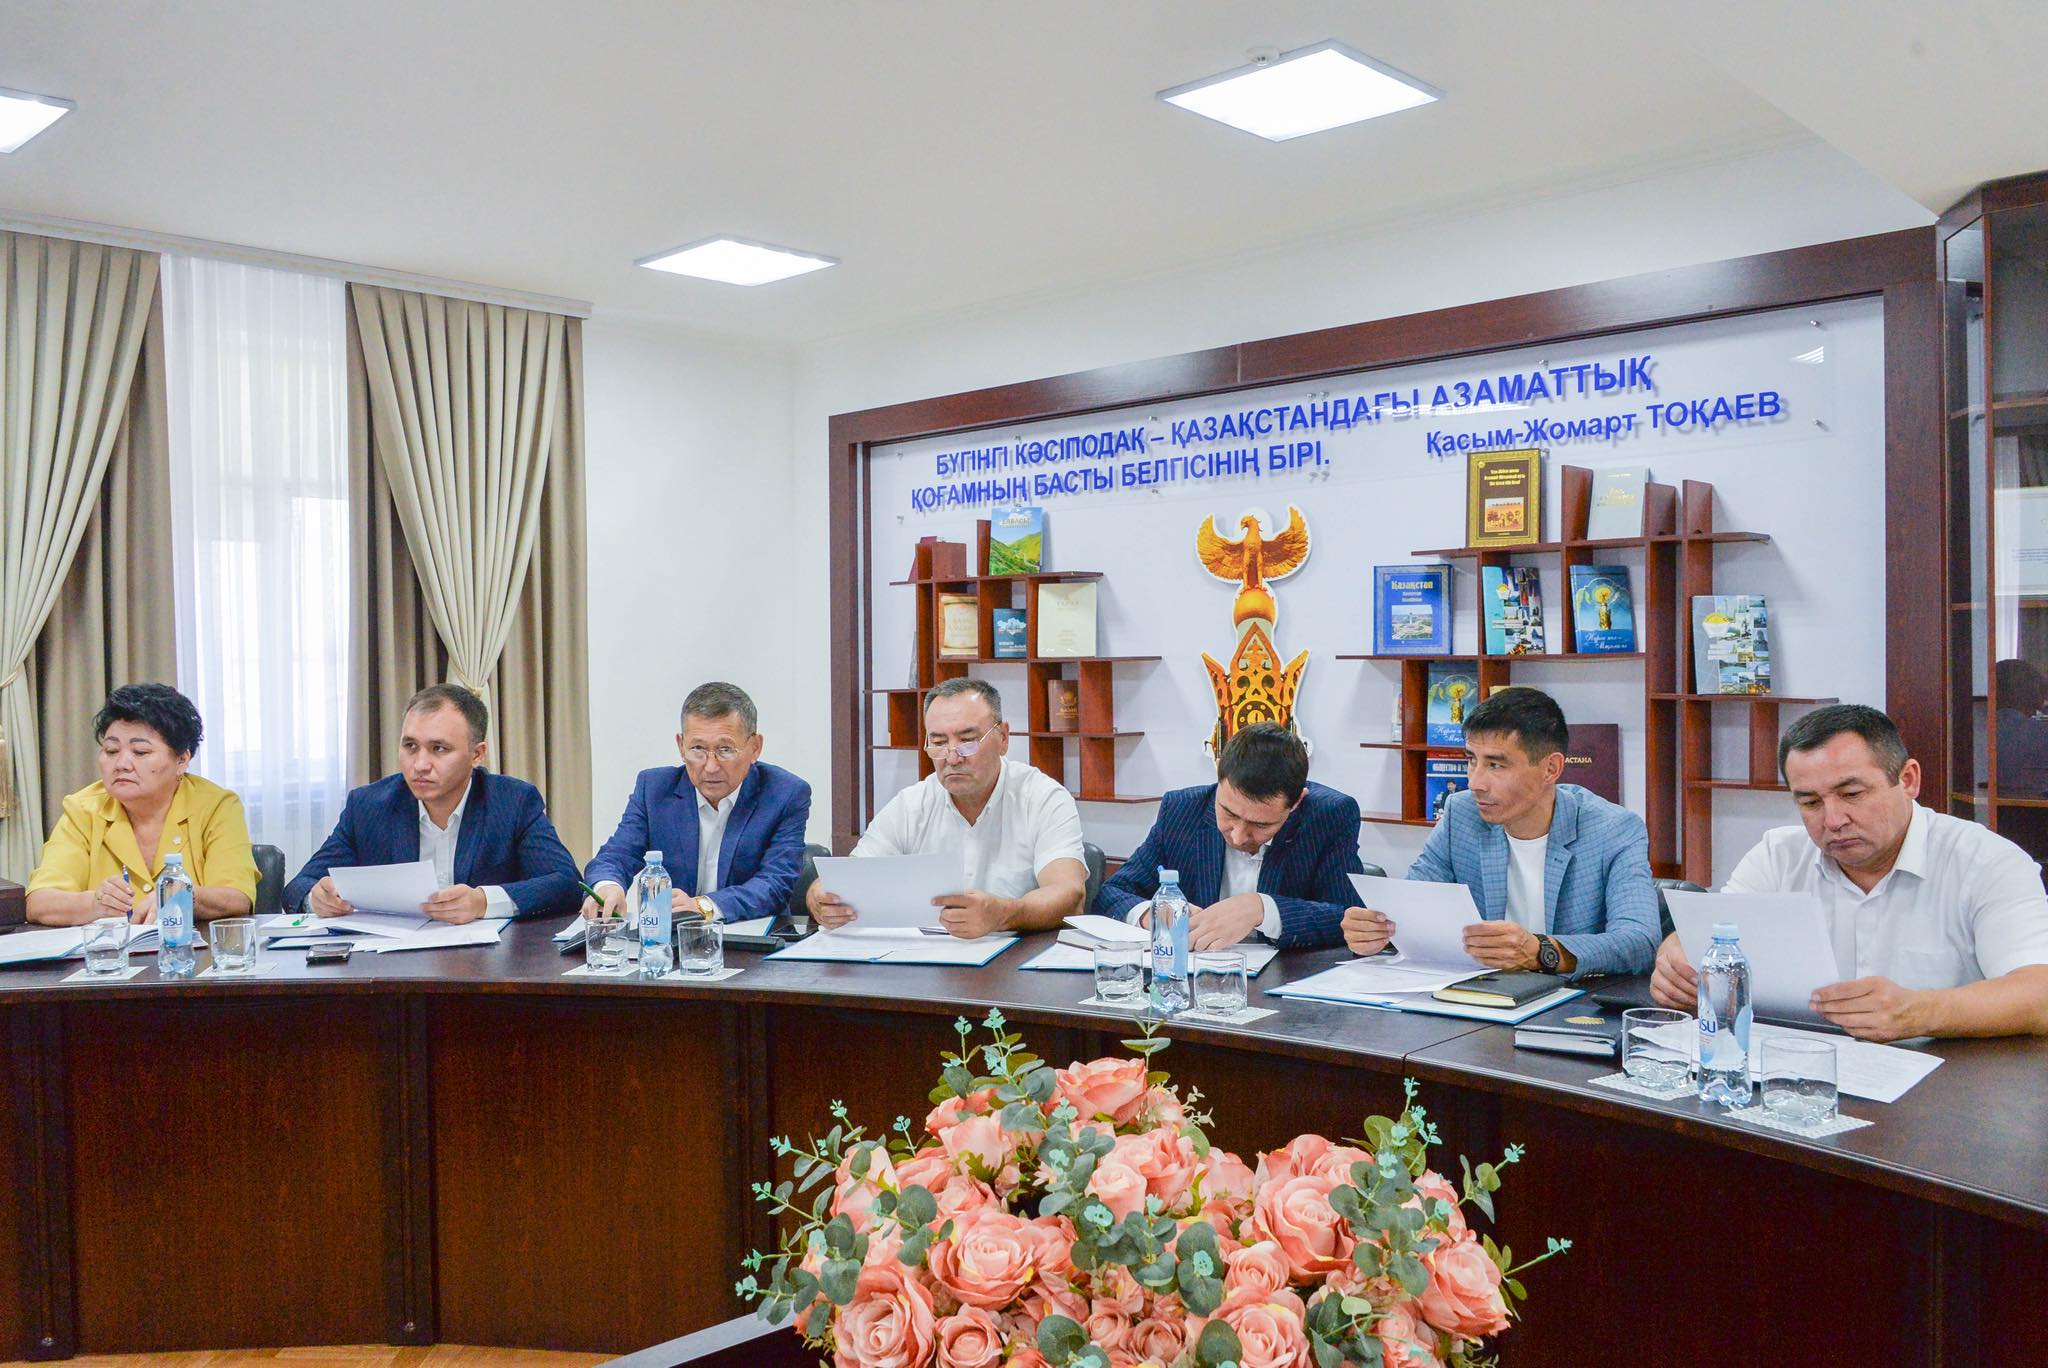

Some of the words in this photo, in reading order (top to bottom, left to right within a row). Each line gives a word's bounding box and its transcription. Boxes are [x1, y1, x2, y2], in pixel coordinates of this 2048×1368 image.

[936, 446, 1008, 475] БҮГІНГІ
[1015, 427, 1145, 465] КӘСІПОДАҚ
[1171, 389, 1419, 448] ҚАЗАҚСТАНДАҒЫ
[1431, 355, 1651, 408] АЗАМАТТЫҚ
[1426, 413, 1637, 456] Қасым-Жомарт
[1646, 391, 1781, 428] ТОҚАЕВ
[911, 476, 1027, 512] ҚОҒАМНЫҢ
[1034, 466, 1113, 496] БАСТЫ
[1121, 448, 1260, 487] БЕЛГІСІНІҢ
[1268, 441, 1330, 470] БІРІ.
